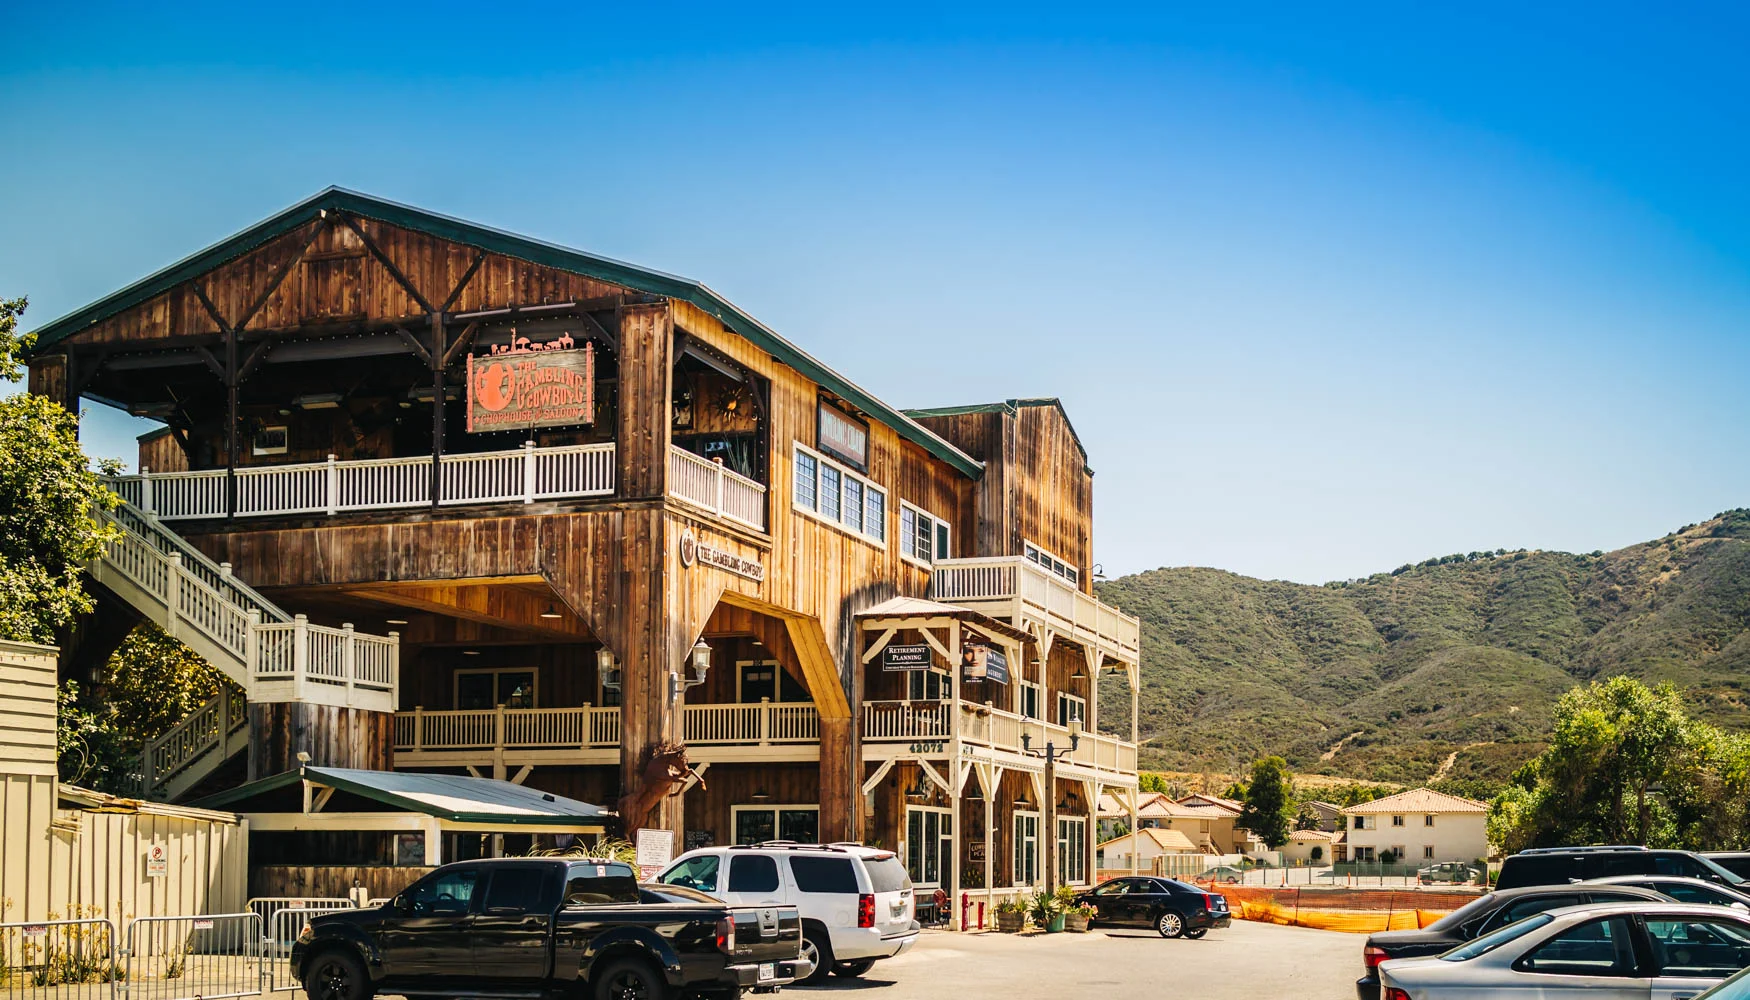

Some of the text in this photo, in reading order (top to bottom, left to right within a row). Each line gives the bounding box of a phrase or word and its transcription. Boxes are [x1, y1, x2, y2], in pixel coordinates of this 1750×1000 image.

[517, 361, 537, 375] THE
[516, 367, 584, 410] GAMBLING
[526, 385, 577, 408] COWBOY
[481, 411, 532, 424] CHOPHOUSE
[544, 408, 579, 420] SALOON
[700, 546, 763, 578] THE GAMBLING COWBOY
[910, 743, 944, 753] 42072
